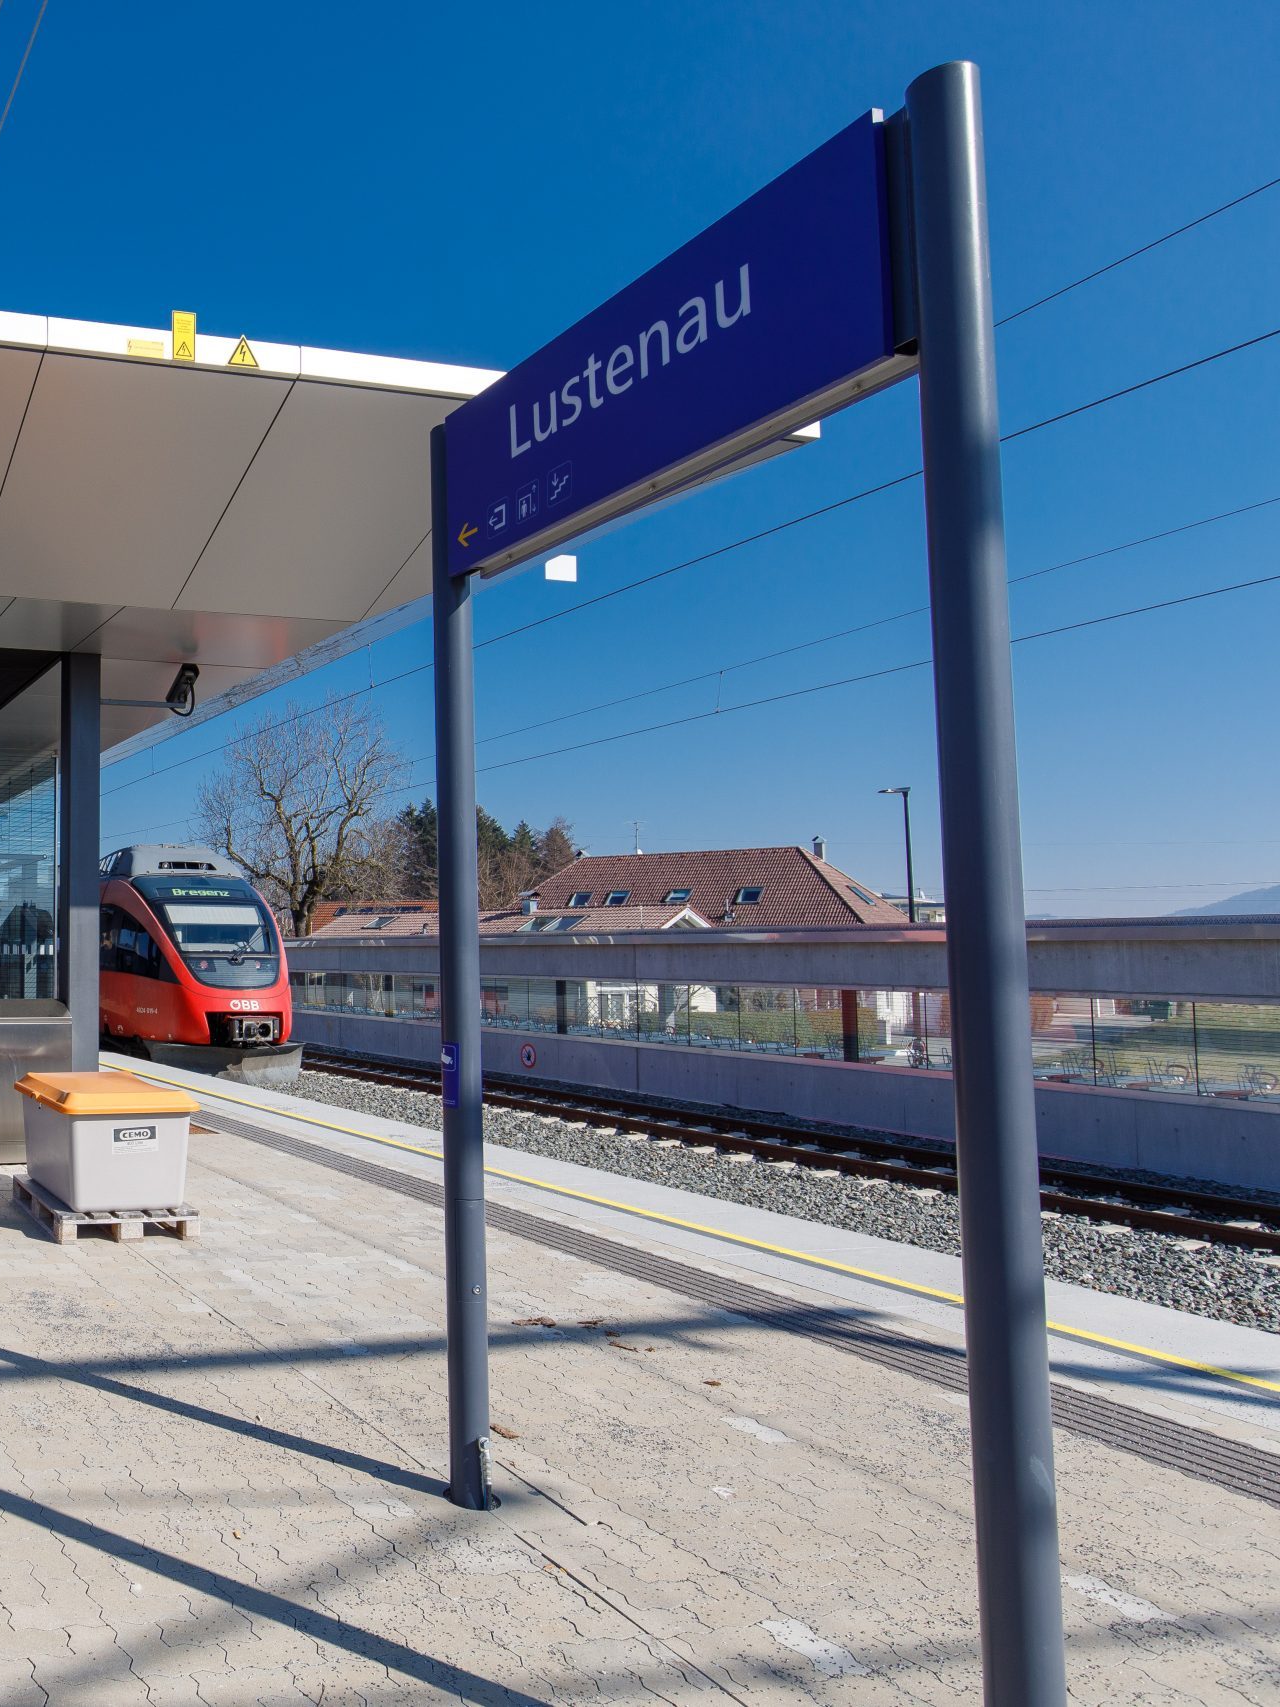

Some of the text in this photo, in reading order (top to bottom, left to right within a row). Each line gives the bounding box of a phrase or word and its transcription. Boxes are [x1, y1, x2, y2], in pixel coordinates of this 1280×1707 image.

[510, 263, 752, 459] Lustenau
[171, 888, 230, 897] Bregenz
[122, 1130, 149, 1138] CEMO
